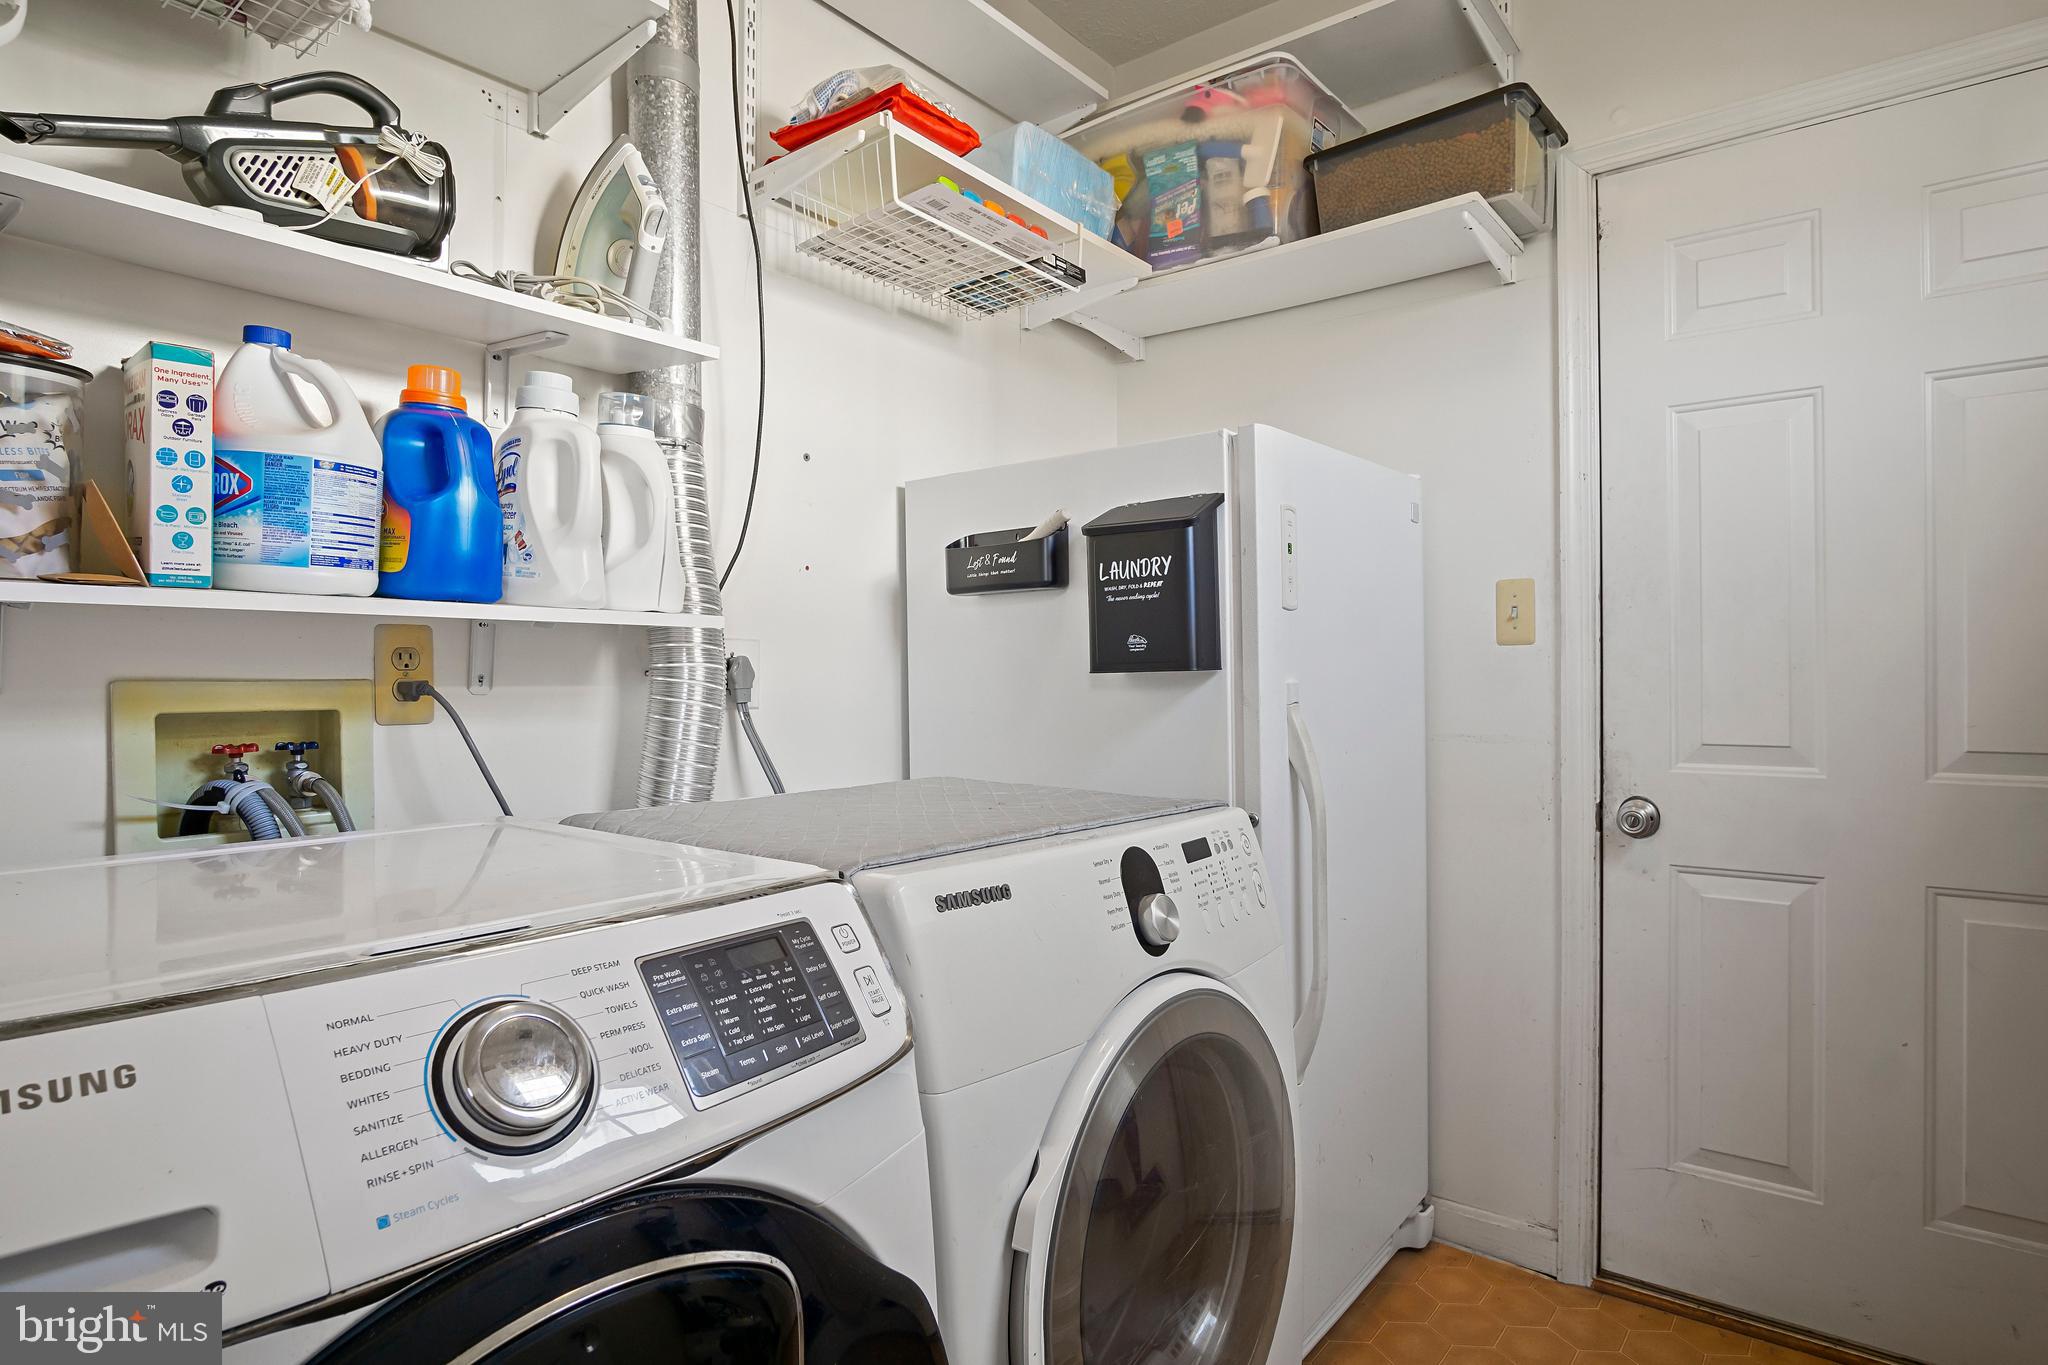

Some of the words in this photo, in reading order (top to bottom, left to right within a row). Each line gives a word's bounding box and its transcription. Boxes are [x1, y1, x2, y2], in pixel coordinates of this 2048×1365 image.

[154, 366, 170, 375] One
[157, 375, 179, 385] Many
[383, 527, 396, 536] MAX
[984, 553, 991, 566] &
[1099, 554, 1173, 582] LAUNDRY
[1143, 580, 1164, 589] REPEAT
[934, 883, 1013, 913] SAMSUNG
[791, 937, 800, 945] My
[799, 934, 811, 944] Cycle
[570, 963, 593, 977] DEEP
[593, 960, 621, 973] STEAM
[806, 965, 818, 974] Delay
[818, 962, 827, 970] End
[652, 973, 664, 982] Pre
[664, 968, 681, 979] Wash
[669, 975, 686, 985] Control
[781, 976, 796, 984] Heavy
[579, 985, 605, 1000] QUICK
[604, 981, 630, 996] WASH
[748, 985, 762, 994] Extra
[761, 982, 773, 991] High
[868, 988, 881, 997] START
[714, 996, 728, 1005] Extra
[727, 994, 737, 1002] Hot
[753, 995, 766, 1004] High
[790, 993, 807, 1003] Normal
[818, 993, 827, 1002] Self
[604, 1000, 638, 1015] TOWELS
[665, 1005, 683, 1017] Extra
[682, 1001, 700, 1012] Rinse
[719, 1007, 731, 1015] Hot
[758, 1003, 777, 1013] Medium
[326, 1013, 375, 1032] NORMAL
[723, 1016, 740, 1025] Warm
[799, 1013, 812, 1022] Light
[599, 1026, 621, 1041] PERM
[620, 1021, 646, 1037] PRESS
[728, 1026, 741, 1035] Cold
[767, 1025, 775, 1034] No
[774, 1022, 785, 1031] Spin
[829, 1020, 843, 1031] Super
[681, 1036, 697, 1048] Extra
[697, 1031, 712, 1043] Spin
[733, 1037, 743, 1046] Tap
[742, 1033, 755, 1042] Cold
[801, 1034, 812, 1043] Soil
[811, 1029, 825, 1039] Level
[333, 1041, 372, 1059] HEAVY
[373, 1034, 403, 1050] DUTY
[628, 1042, 654, 1056] WOOL
[775, 1044, 789, 1054] Spin
[739, 1056, 758, 1067] Temp.
[340, 1063, 391, 1084] BEDDING
[618, 1062, 662, 1083] DELICATES
[700, 1067, 720, 1081] Steam
[346, 1090, 391, 1111] WHITES
[615, 1089, 644, 1108] ACTIVE
[643, 1082, 671, 1099] WEAR
[353, 1114, 405, 1137] SANITIZE
[360, 1137, 419, 1164] ALLERGEN
[392, 1204, 426, 1223] Steam
[427, 1192, 460, 1215] Cycles
